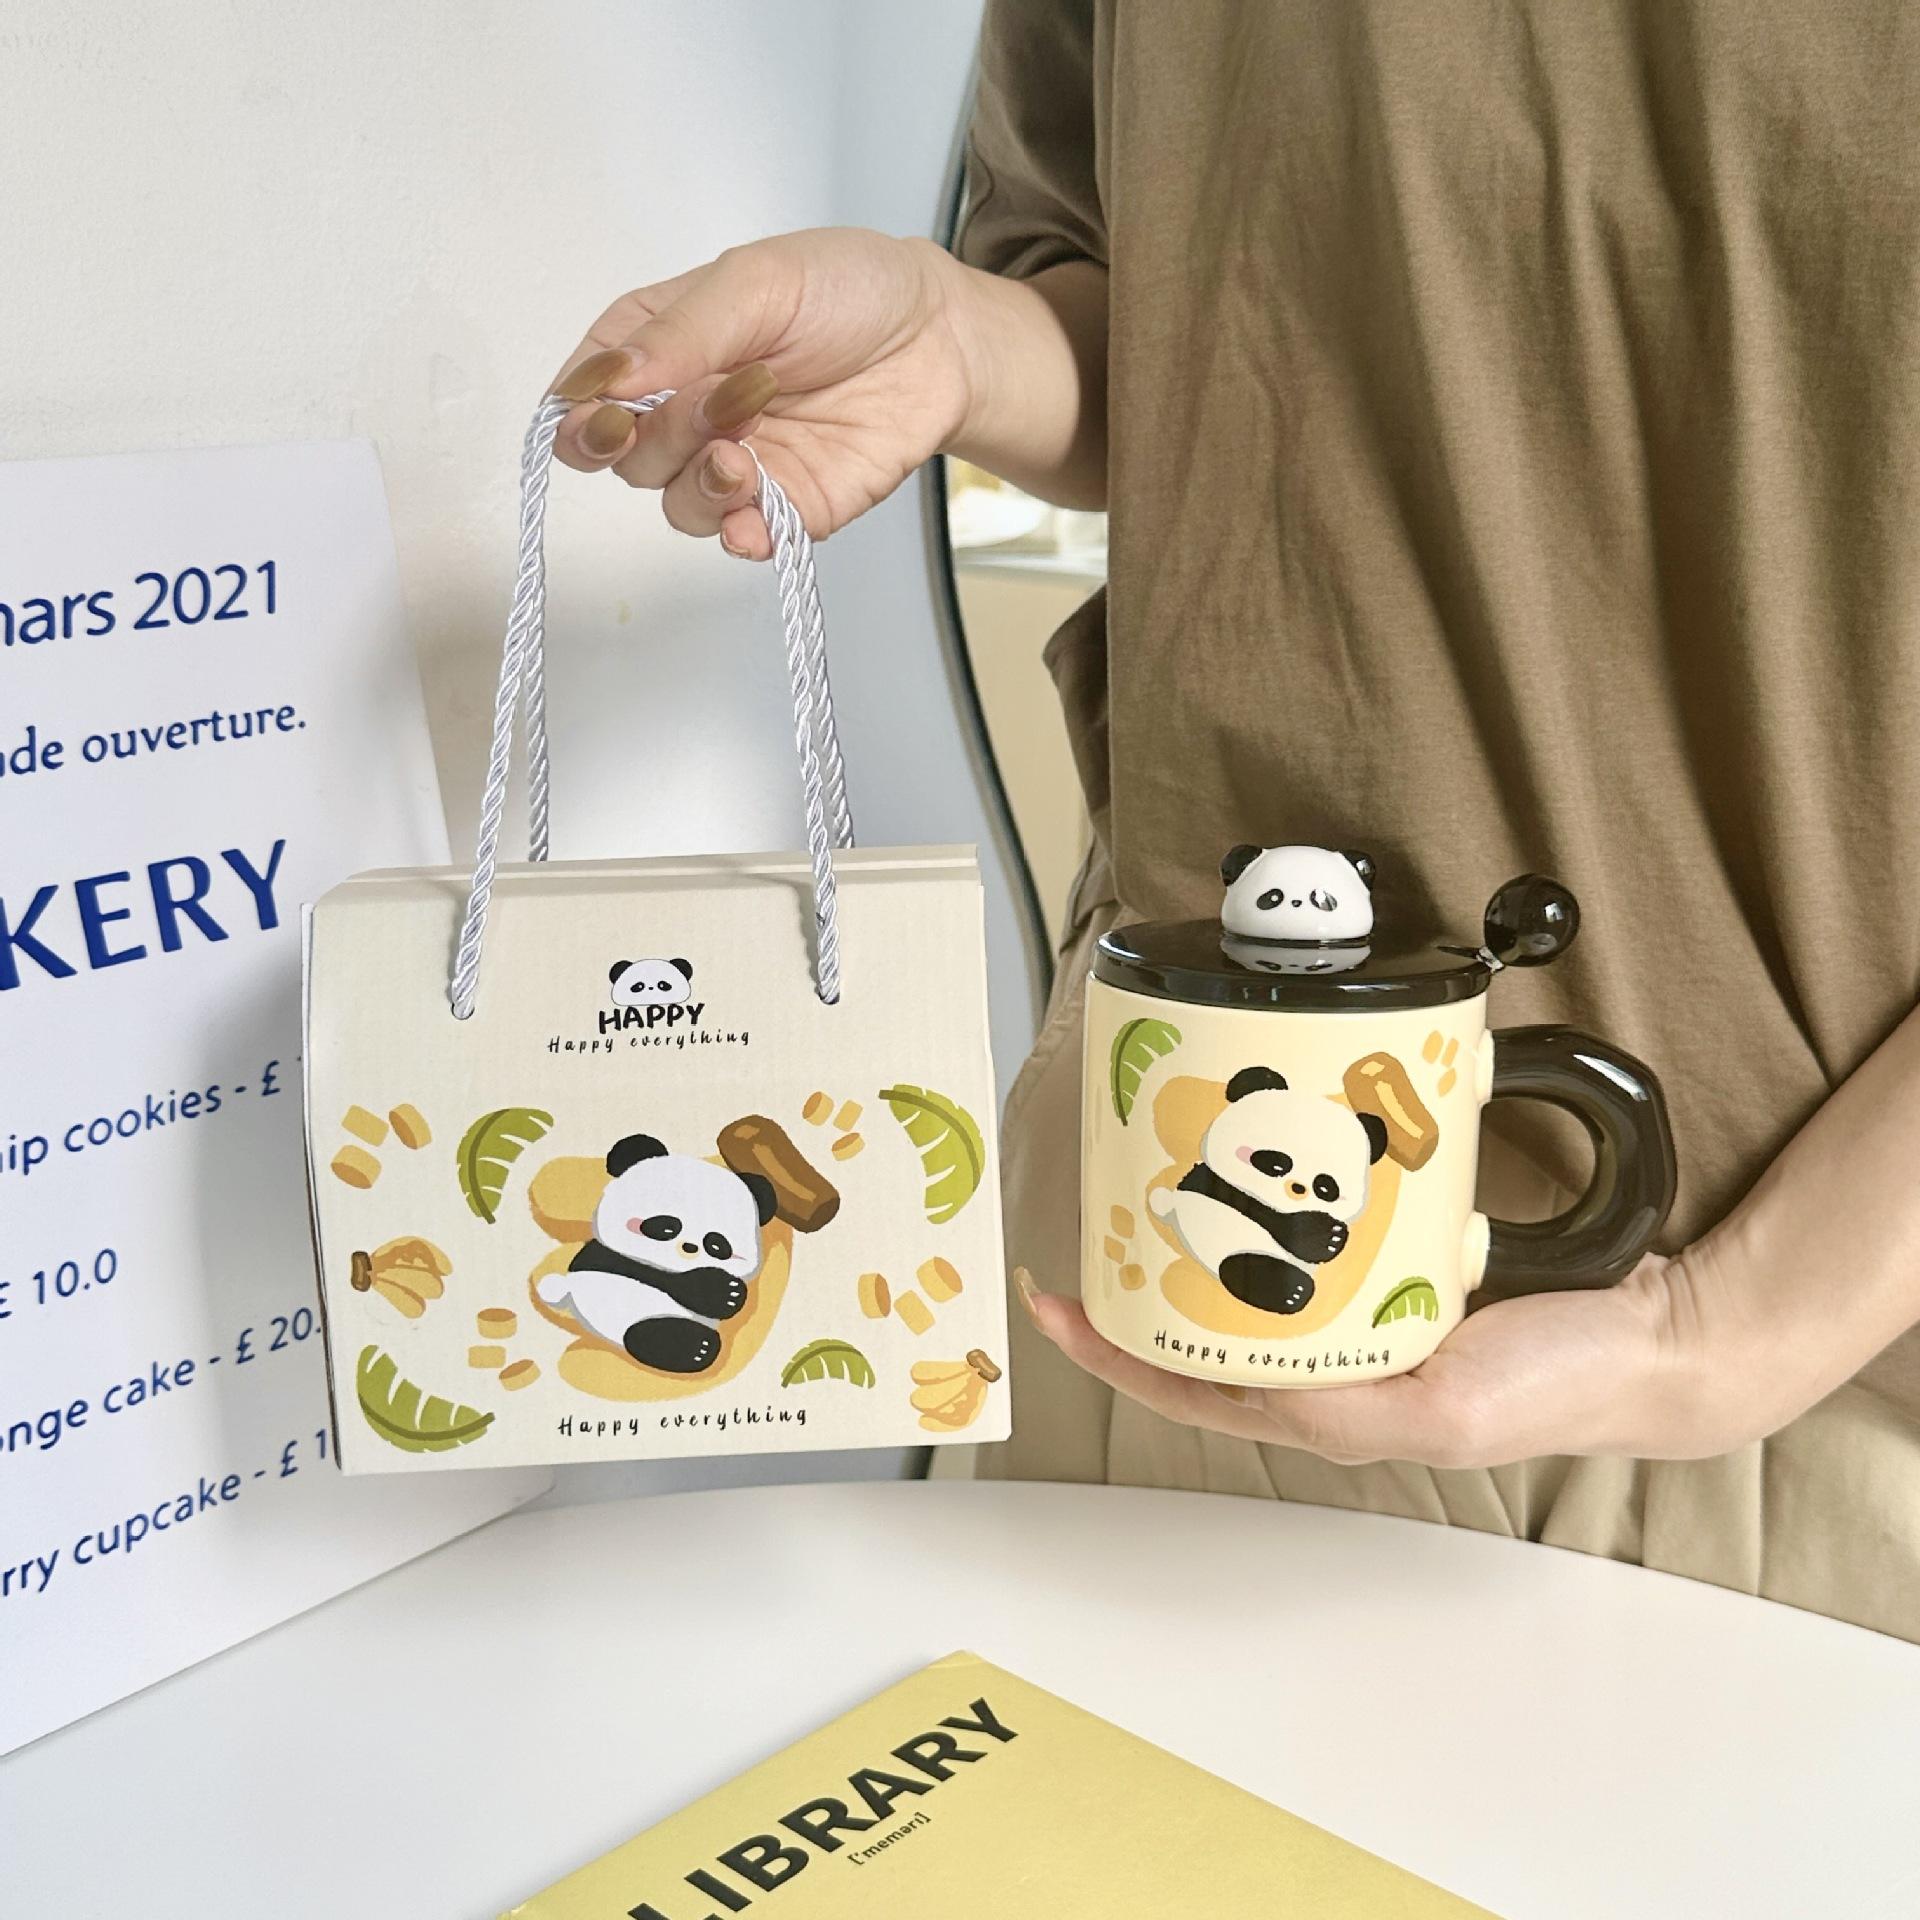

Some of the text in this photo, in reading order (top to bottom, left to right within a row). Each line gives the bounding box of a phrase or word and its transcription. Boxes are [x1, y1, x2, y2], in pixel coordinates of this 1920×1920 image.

[134, 561, 276, 630] 2021
[0, 705, 306, 777] de ouverture.
[548, 1029, 750, 1053] Happy everything
[599, 1003, 705, 1034] HAPPY
[0, 1134, 48, 1175] ip
[64, 1084, 222, 1153] cookies
[33, 1248, 117, 1305] 10.0
[1154, 1330, 1390, 1373] Happy everything
[0, 1399, 89, 1452] nge
[104, 1360, 196, 1413] cake
[558, 1405, 807, 1437] Happy everything
[74, 1473, 241, 1565] cupcake
